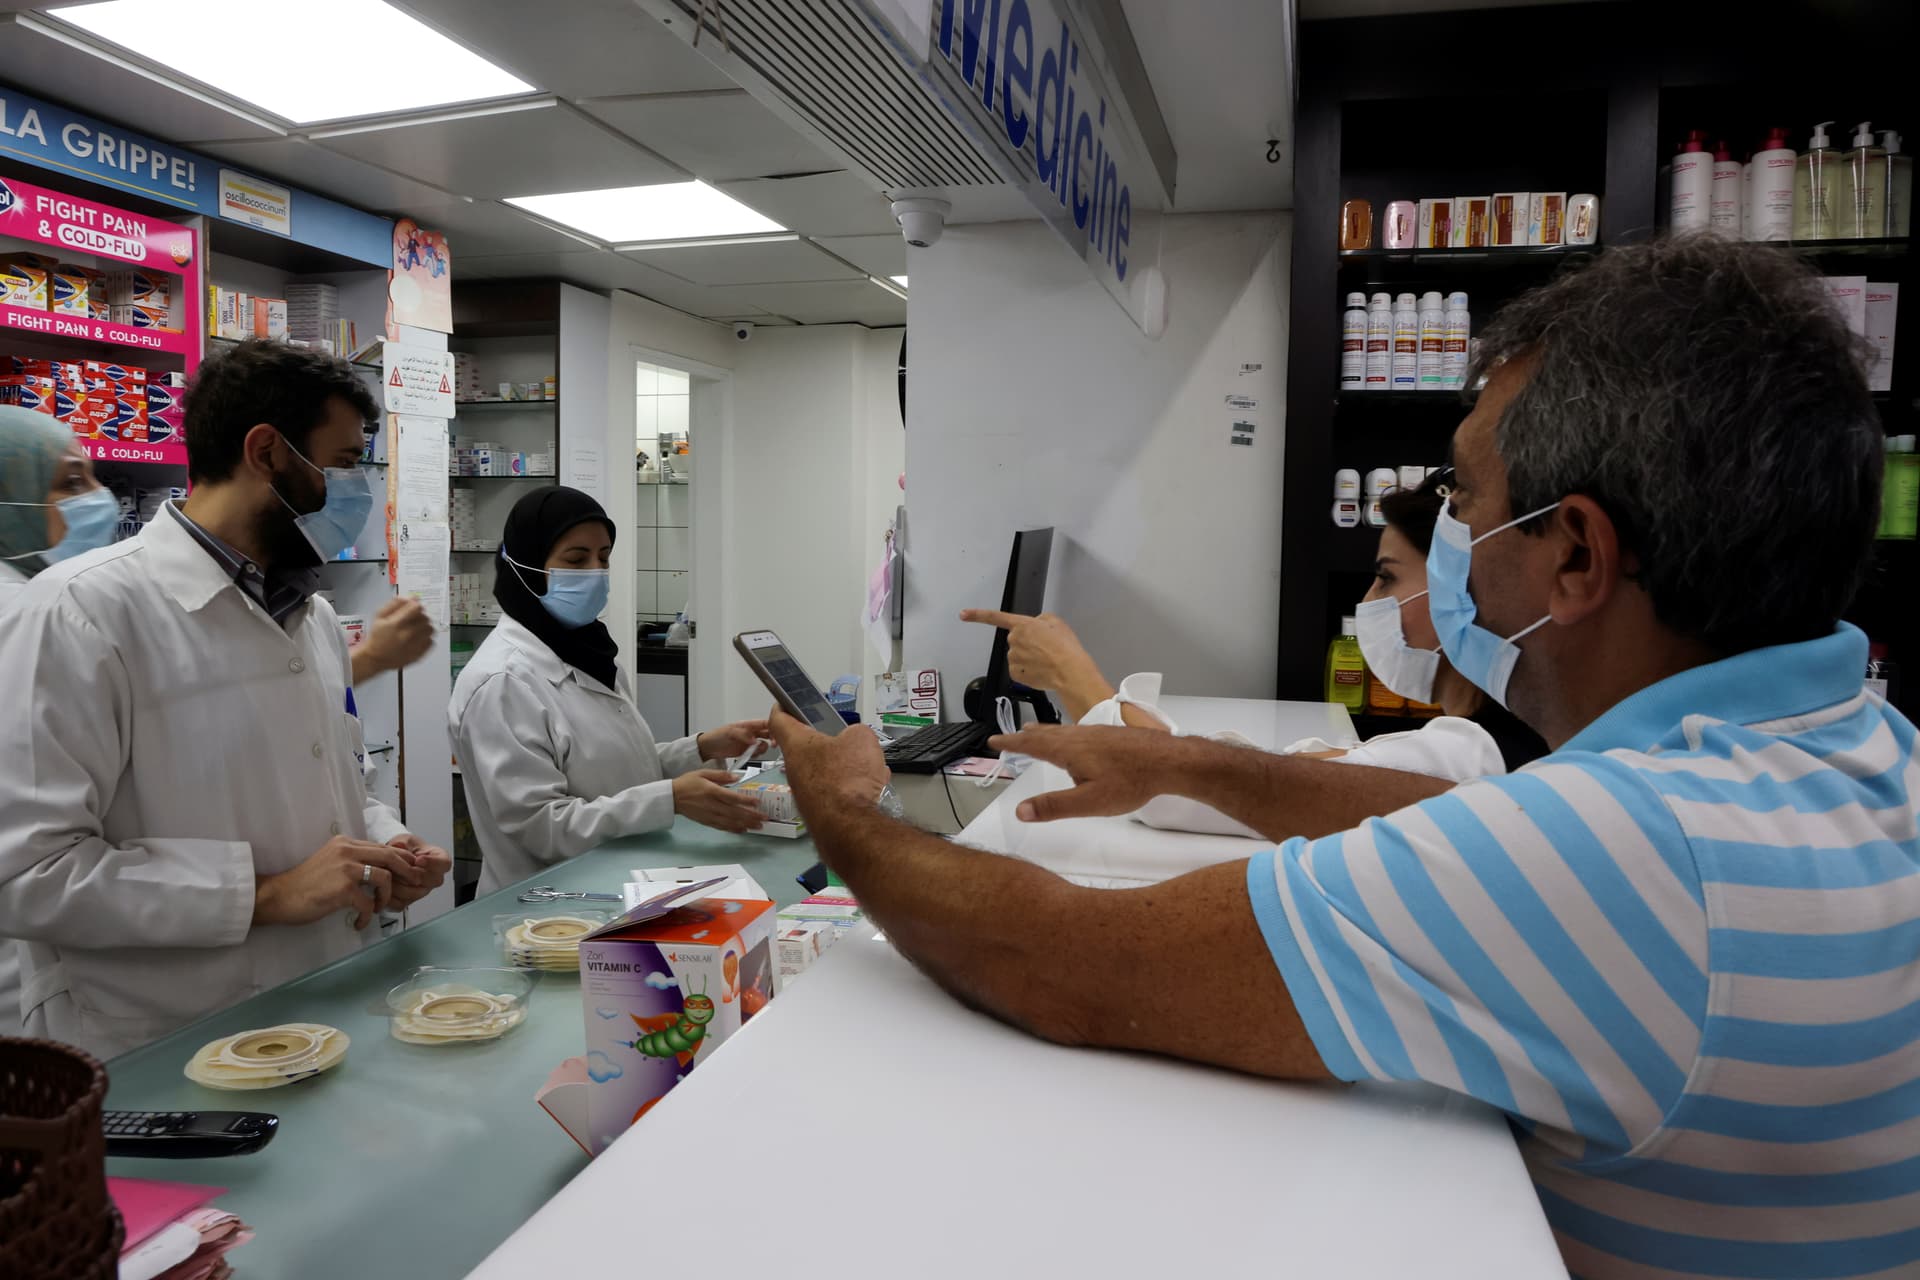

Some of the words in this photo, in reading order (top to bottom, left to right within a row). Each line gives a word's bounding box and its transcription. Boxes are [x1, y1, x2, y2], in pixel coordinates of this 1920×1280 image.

[0, 98, 48, 147] LA
[61, 121, 196, 192] GRIPPE!
[36, 195, 98, 224] FIGHT
[102, 213, 147, 239] PAIN
[225, 191, 287, 217] oscillococcinum
[38, 220, 53, 238] &
[7, 312, 53, 331] FIGHT
[56, 321, 89, 337] PAIN
[95, 327, 104, 339] &
[97, 446, 106, 458] &
[587, 961, 631, 973] VITAMIN
[633, 964, 641, 973] C
